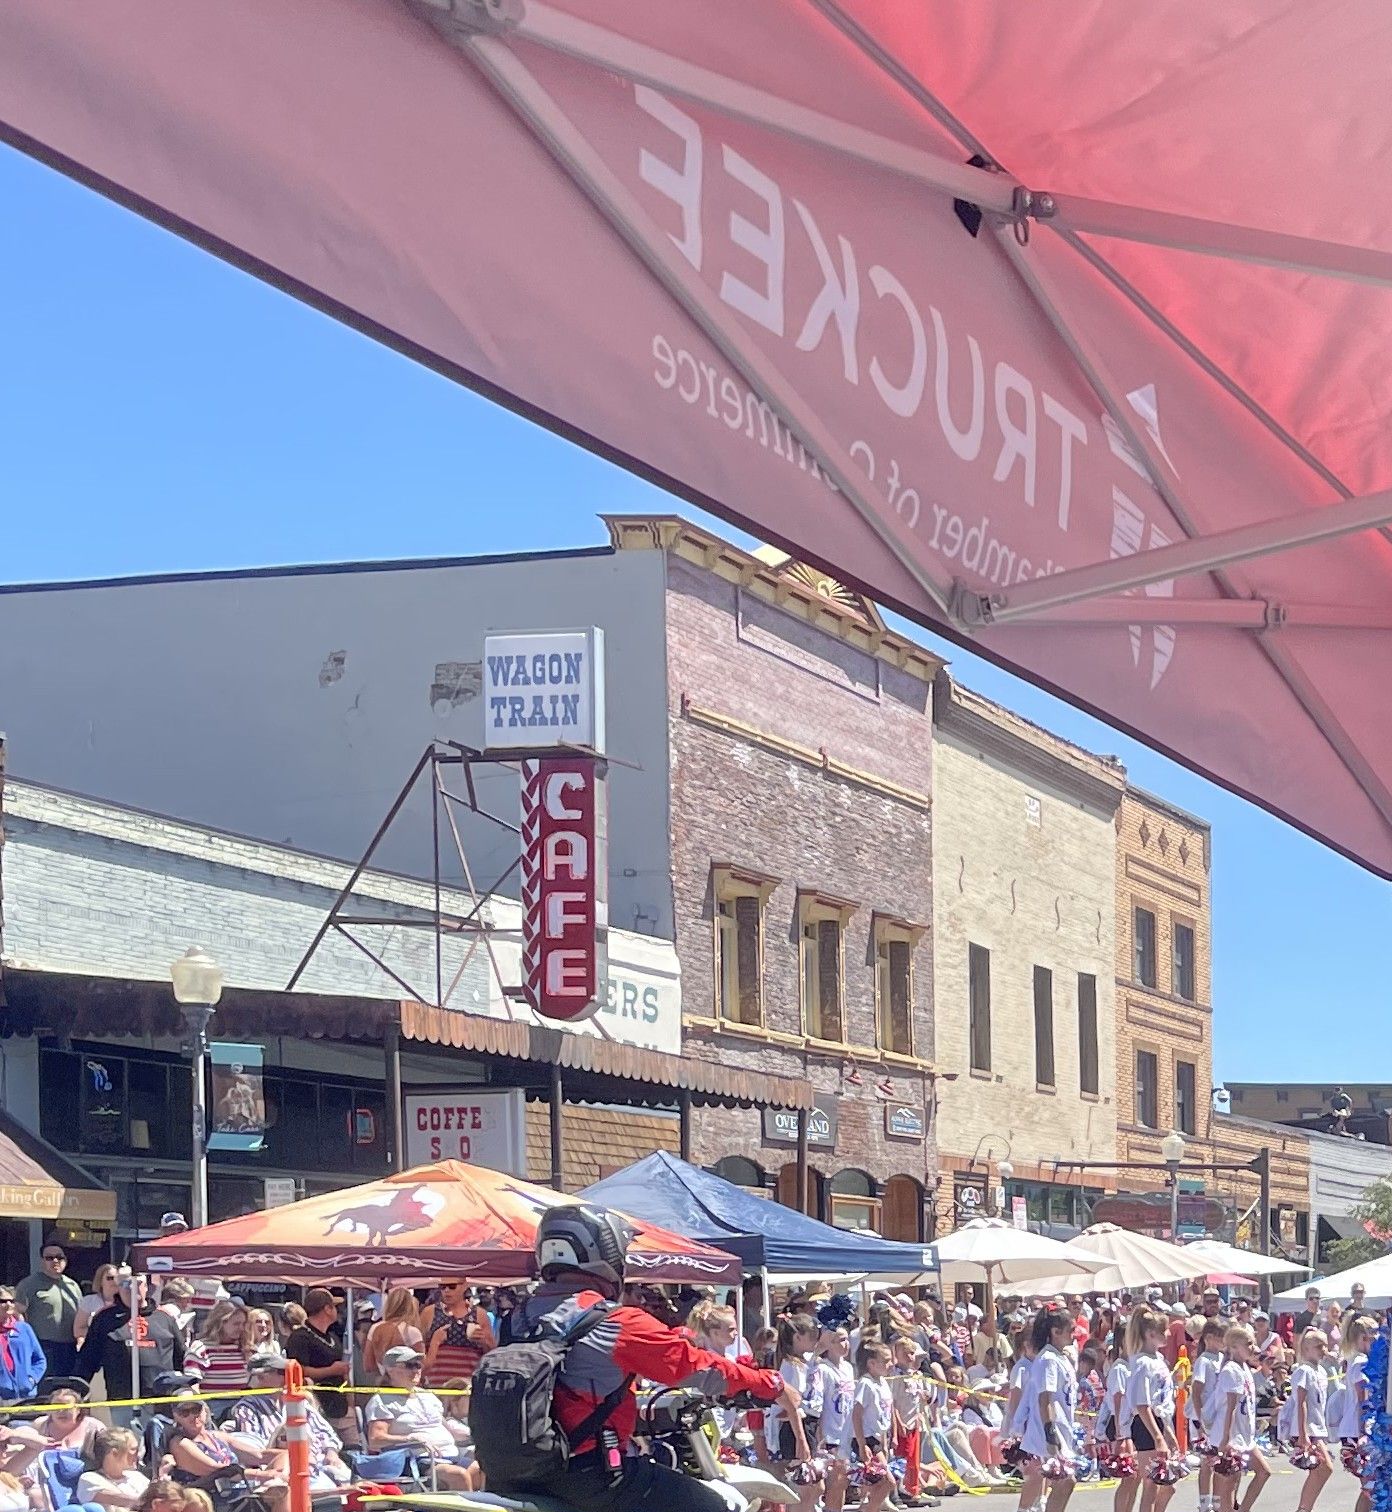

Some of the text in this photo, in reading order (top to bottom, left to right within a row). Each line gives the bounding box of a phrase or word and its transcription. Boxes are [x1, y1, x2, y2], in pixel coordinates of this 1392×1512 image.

[487, 652, 583, 687] WAGON
[490, 694, 580, 728] TRAIN
[544, 772, 588, 997] CAFE
[417, 1106, 482, 1131] COFFE
[775, 1113, 830, 1134] OVEAND
